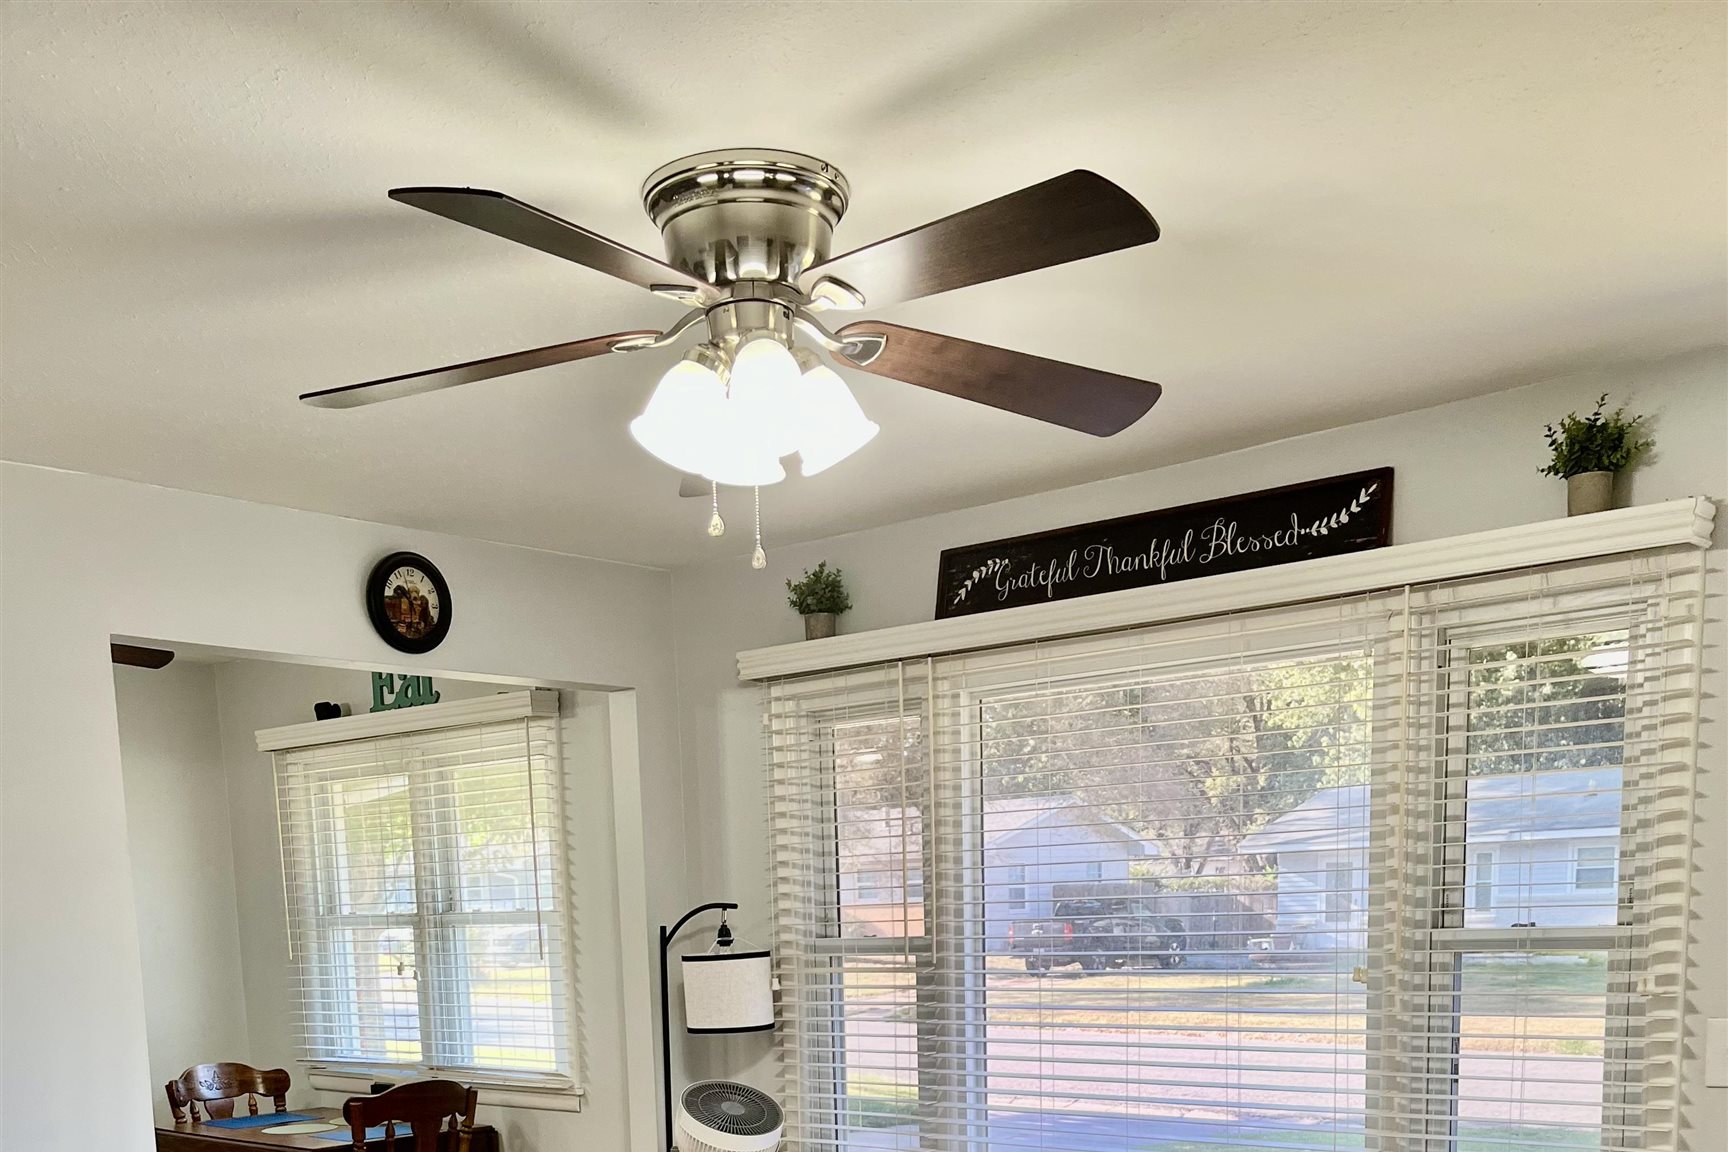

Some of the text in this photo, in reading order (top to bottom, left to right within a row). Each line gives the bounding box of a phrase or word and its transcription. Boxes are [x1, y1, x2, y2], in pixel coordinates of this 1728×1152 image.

[995, 512, 1300, 601] Grateful Thankful Blessed
[393, 569, 403, 580] 11
[406, 568, 415, 578] 12
[386, 578, 393, 590] 10
[427, 587, 436, 595] 2
